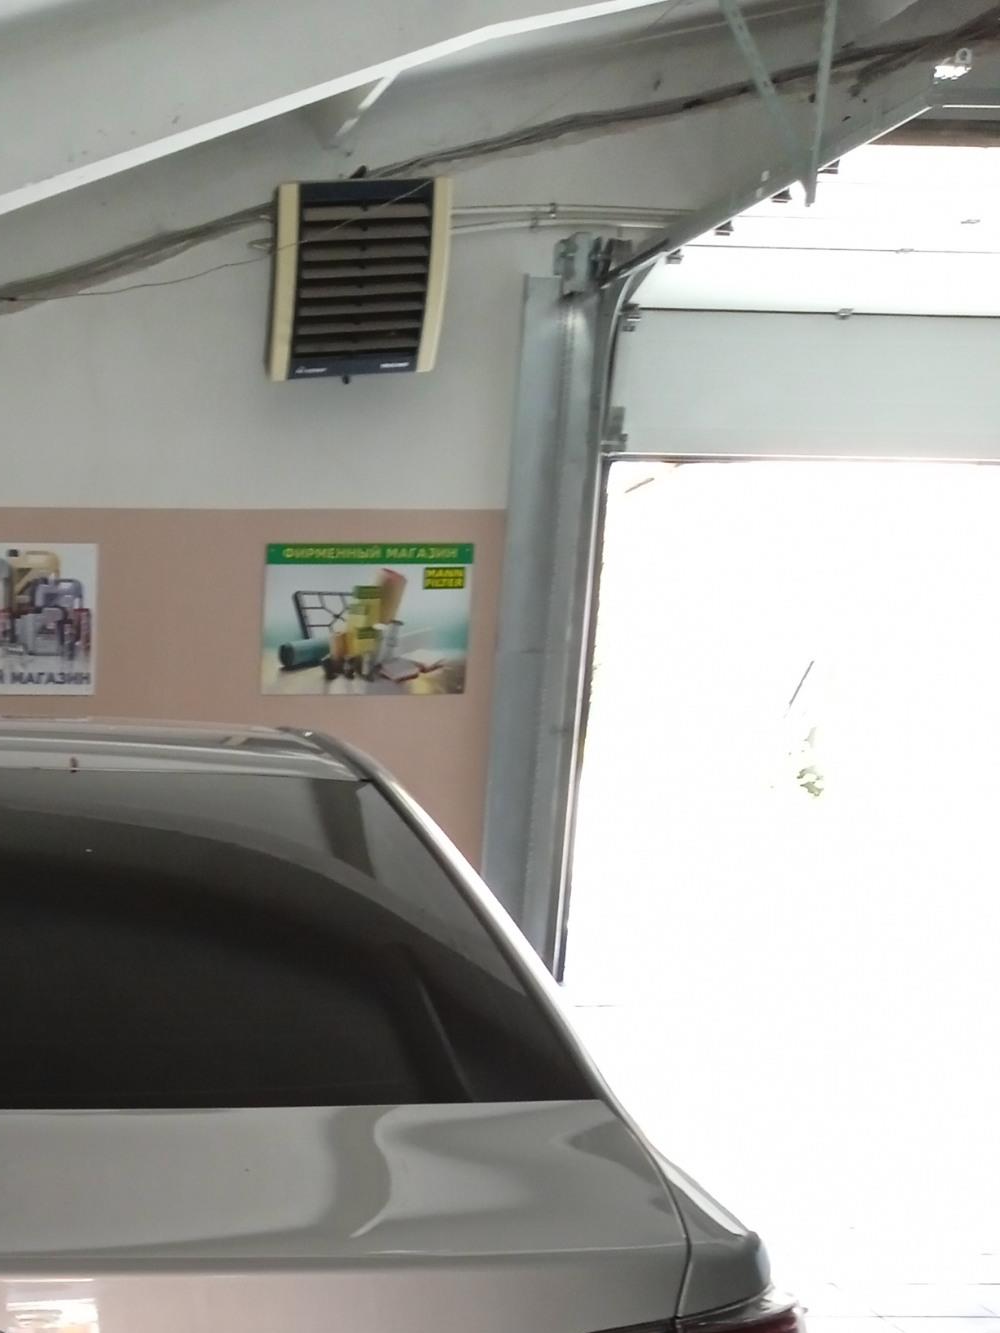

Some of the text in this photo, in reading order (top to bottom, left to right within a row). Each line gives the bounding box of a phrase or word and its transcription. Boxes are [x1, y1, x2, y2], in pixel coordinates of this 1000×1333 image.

[282, 545, 459, 560] ФИРМЕННЫЙ МАГАЗИН
[426, 569, 464, 578] MANN
[10, 671, 91, 685] МАГАЗИН
